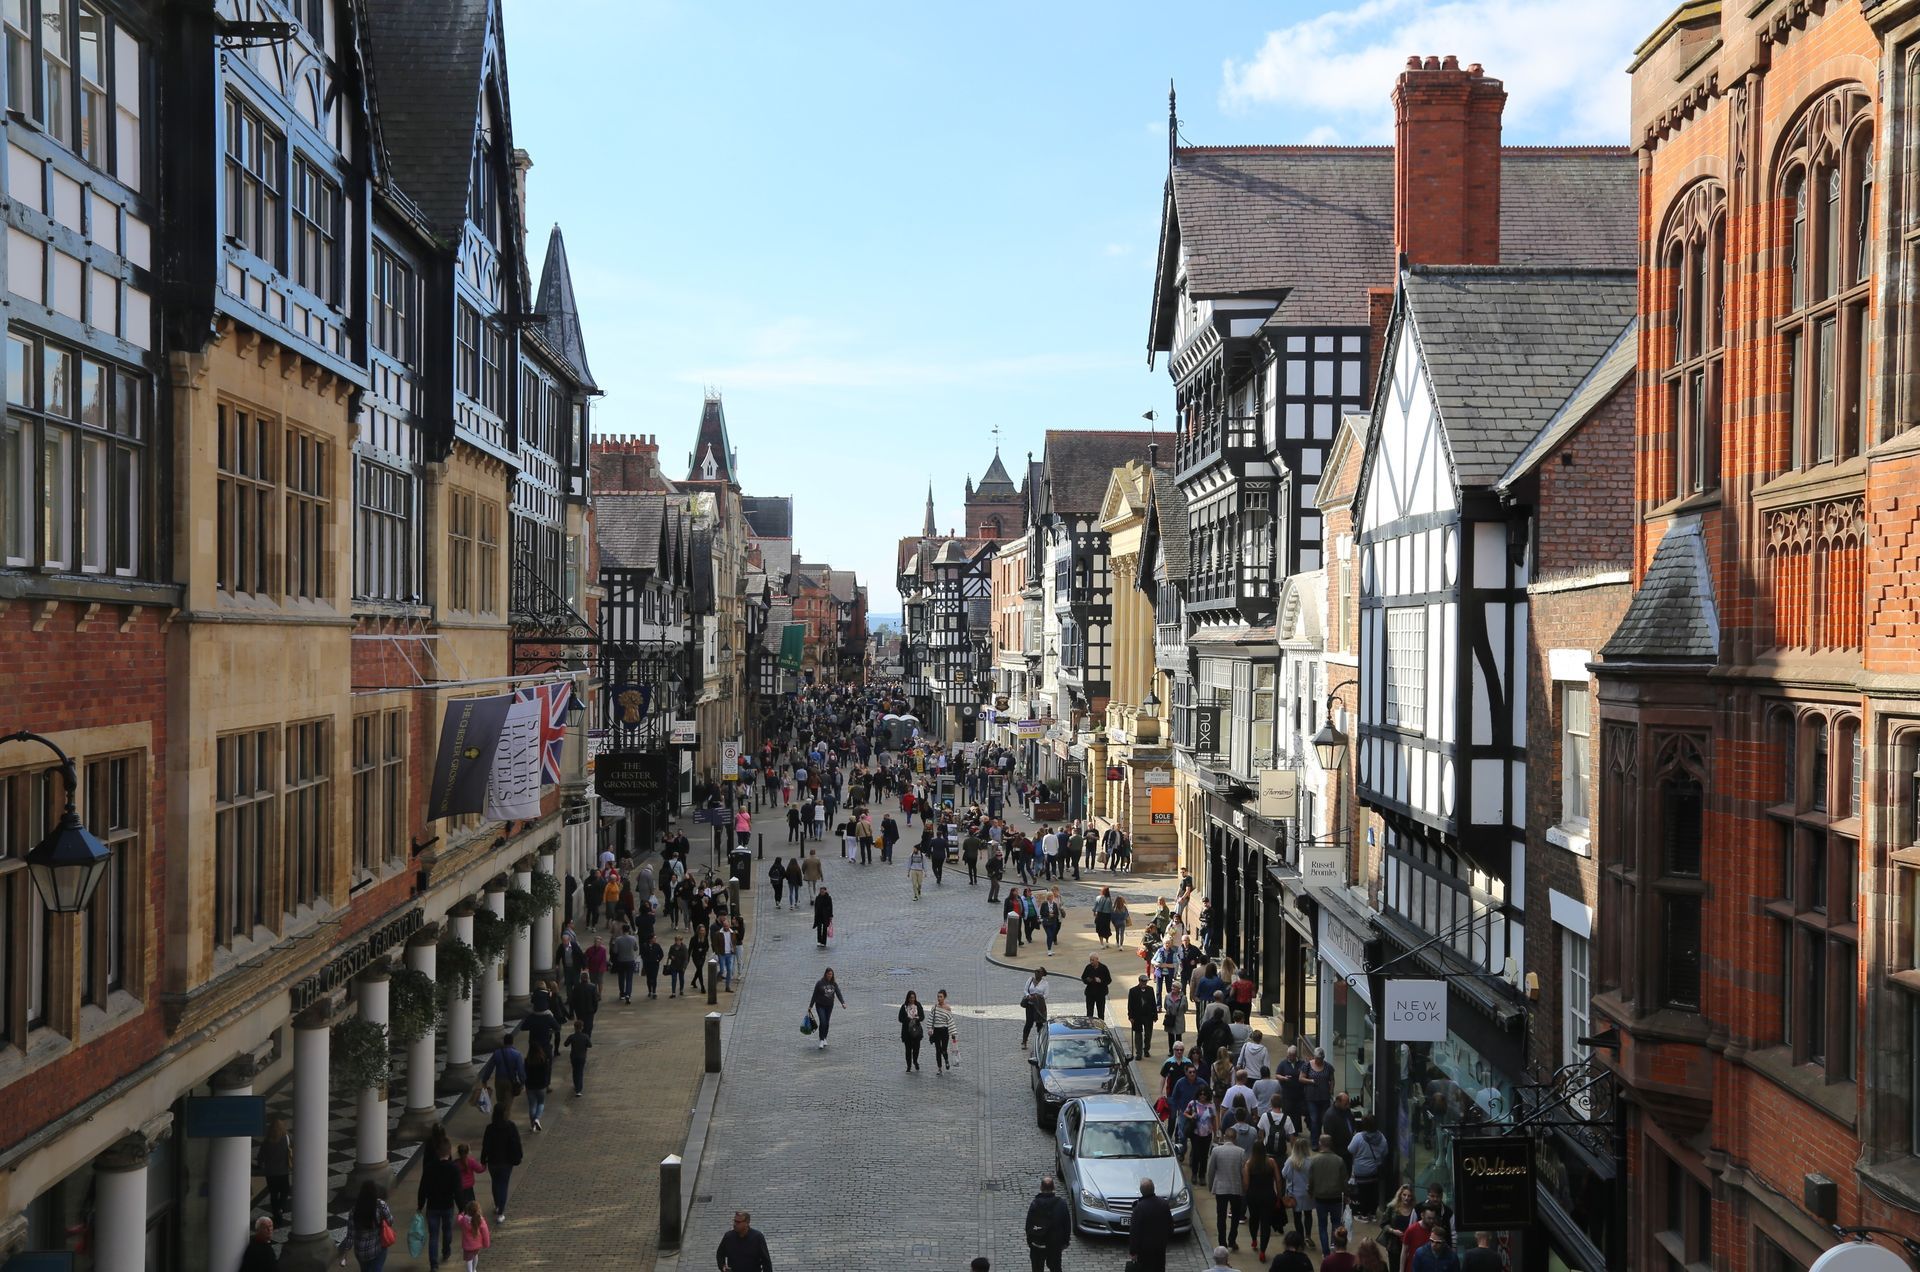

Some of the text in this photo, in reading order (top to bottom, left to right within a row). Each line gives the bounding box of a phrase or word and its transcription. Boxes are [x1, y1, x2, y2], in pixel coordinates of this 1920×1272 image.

[462, 703, 474, 719] THE
[1200, 713, 1211, 749] next
[497, 726, 512, 801] HOTELS
[512, 724, 527, 796] LUXURY
[527, 720, 539, 798] SMALL
[623, 762, 641, 770] THE
[610, 771, 651, 780] CHESTER
[603, 780, 658, 789] GROSVENOR
[1263, 788, 1292, 798] Thorntons
[1311, 861, 1335, 869] Russell
[295, 907, 425, 1010] THE CHESTER GROSVENOR
[1397, 1001, 1437, 1011] NEW
[1393, 1011, 1441, 1022] LOOK
[1463, 1156, 1527, 1176] Waltons
